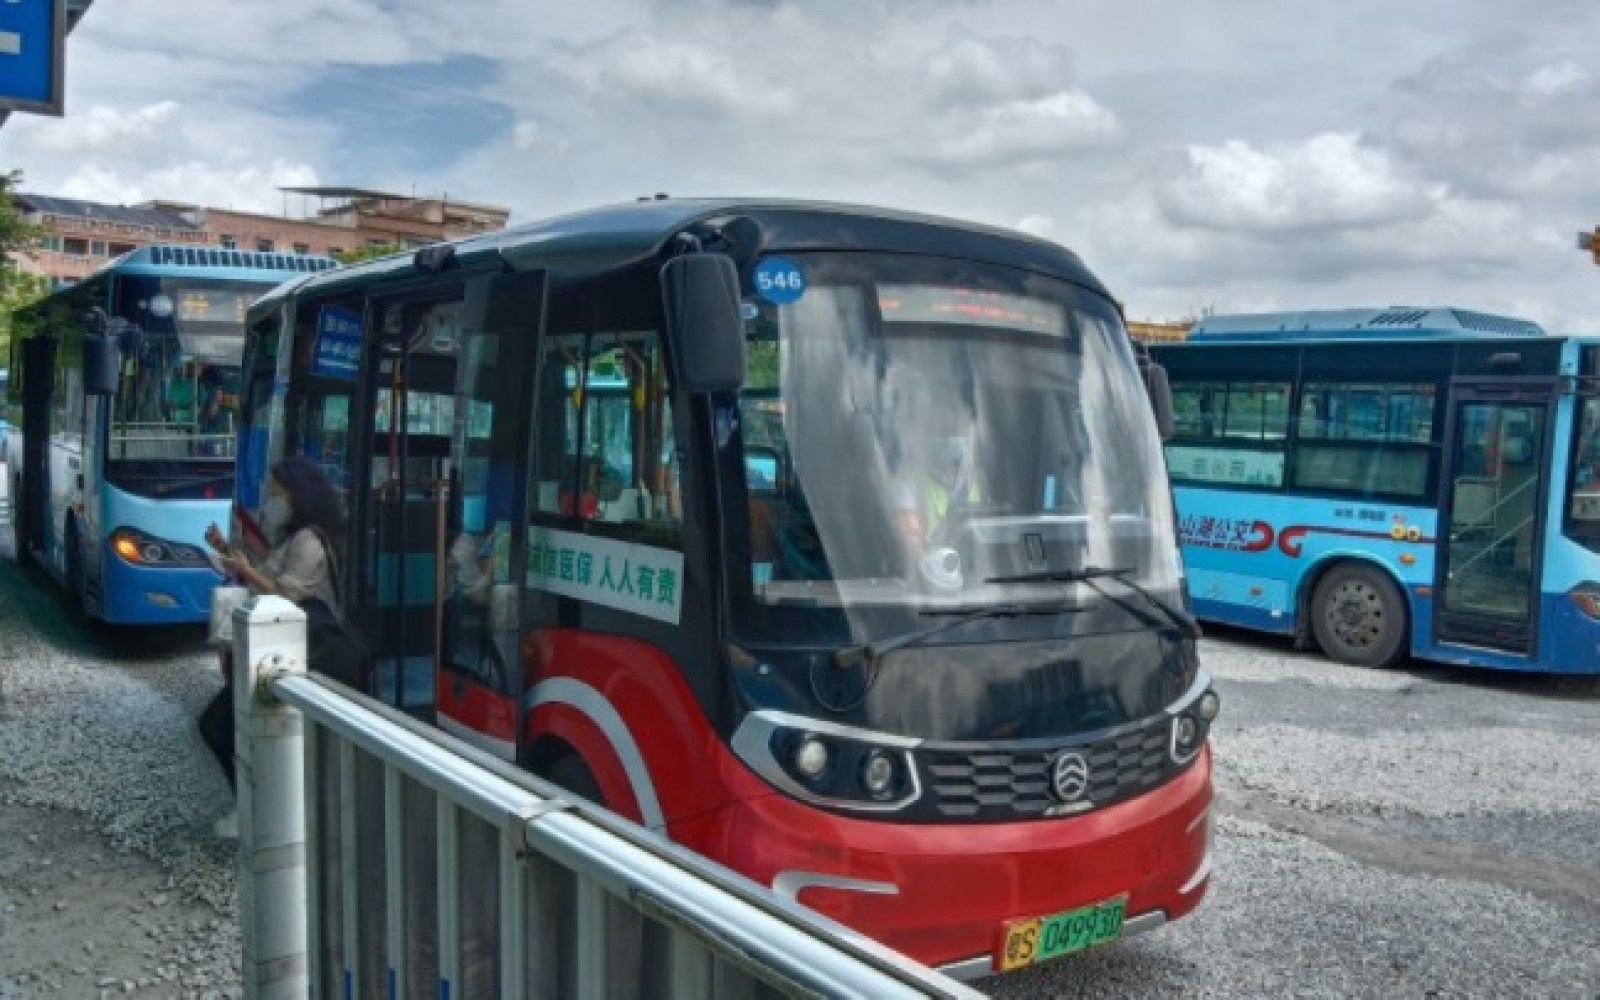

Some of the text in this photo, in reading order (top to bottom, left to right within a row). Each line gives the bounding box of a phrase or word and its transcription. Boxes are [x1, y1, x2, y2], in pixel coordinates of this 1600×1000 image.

[757, 271, 801, 291] 546
[600, 553, 677, 605] 人人有责
